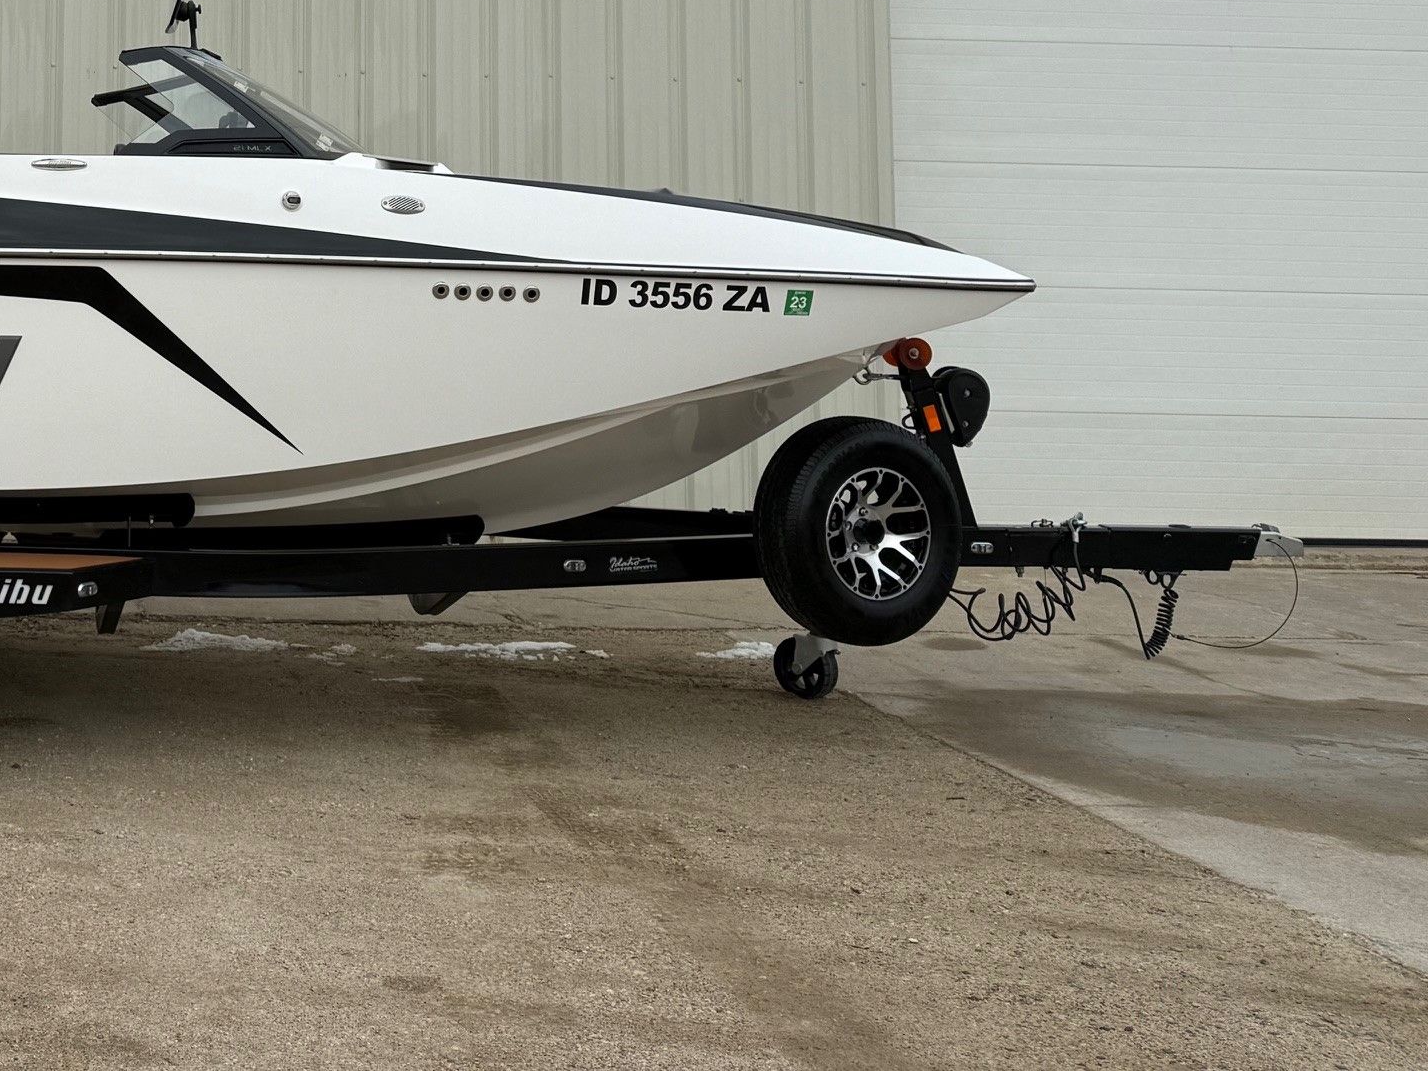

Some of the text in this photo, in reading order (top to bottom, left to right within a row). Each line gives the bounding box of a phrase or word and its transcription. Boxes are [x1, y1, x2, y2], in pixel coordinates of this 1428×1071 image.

[581, 278, 771, 313] ID 3556 ZA
[789, 296, 807, 309] 23
